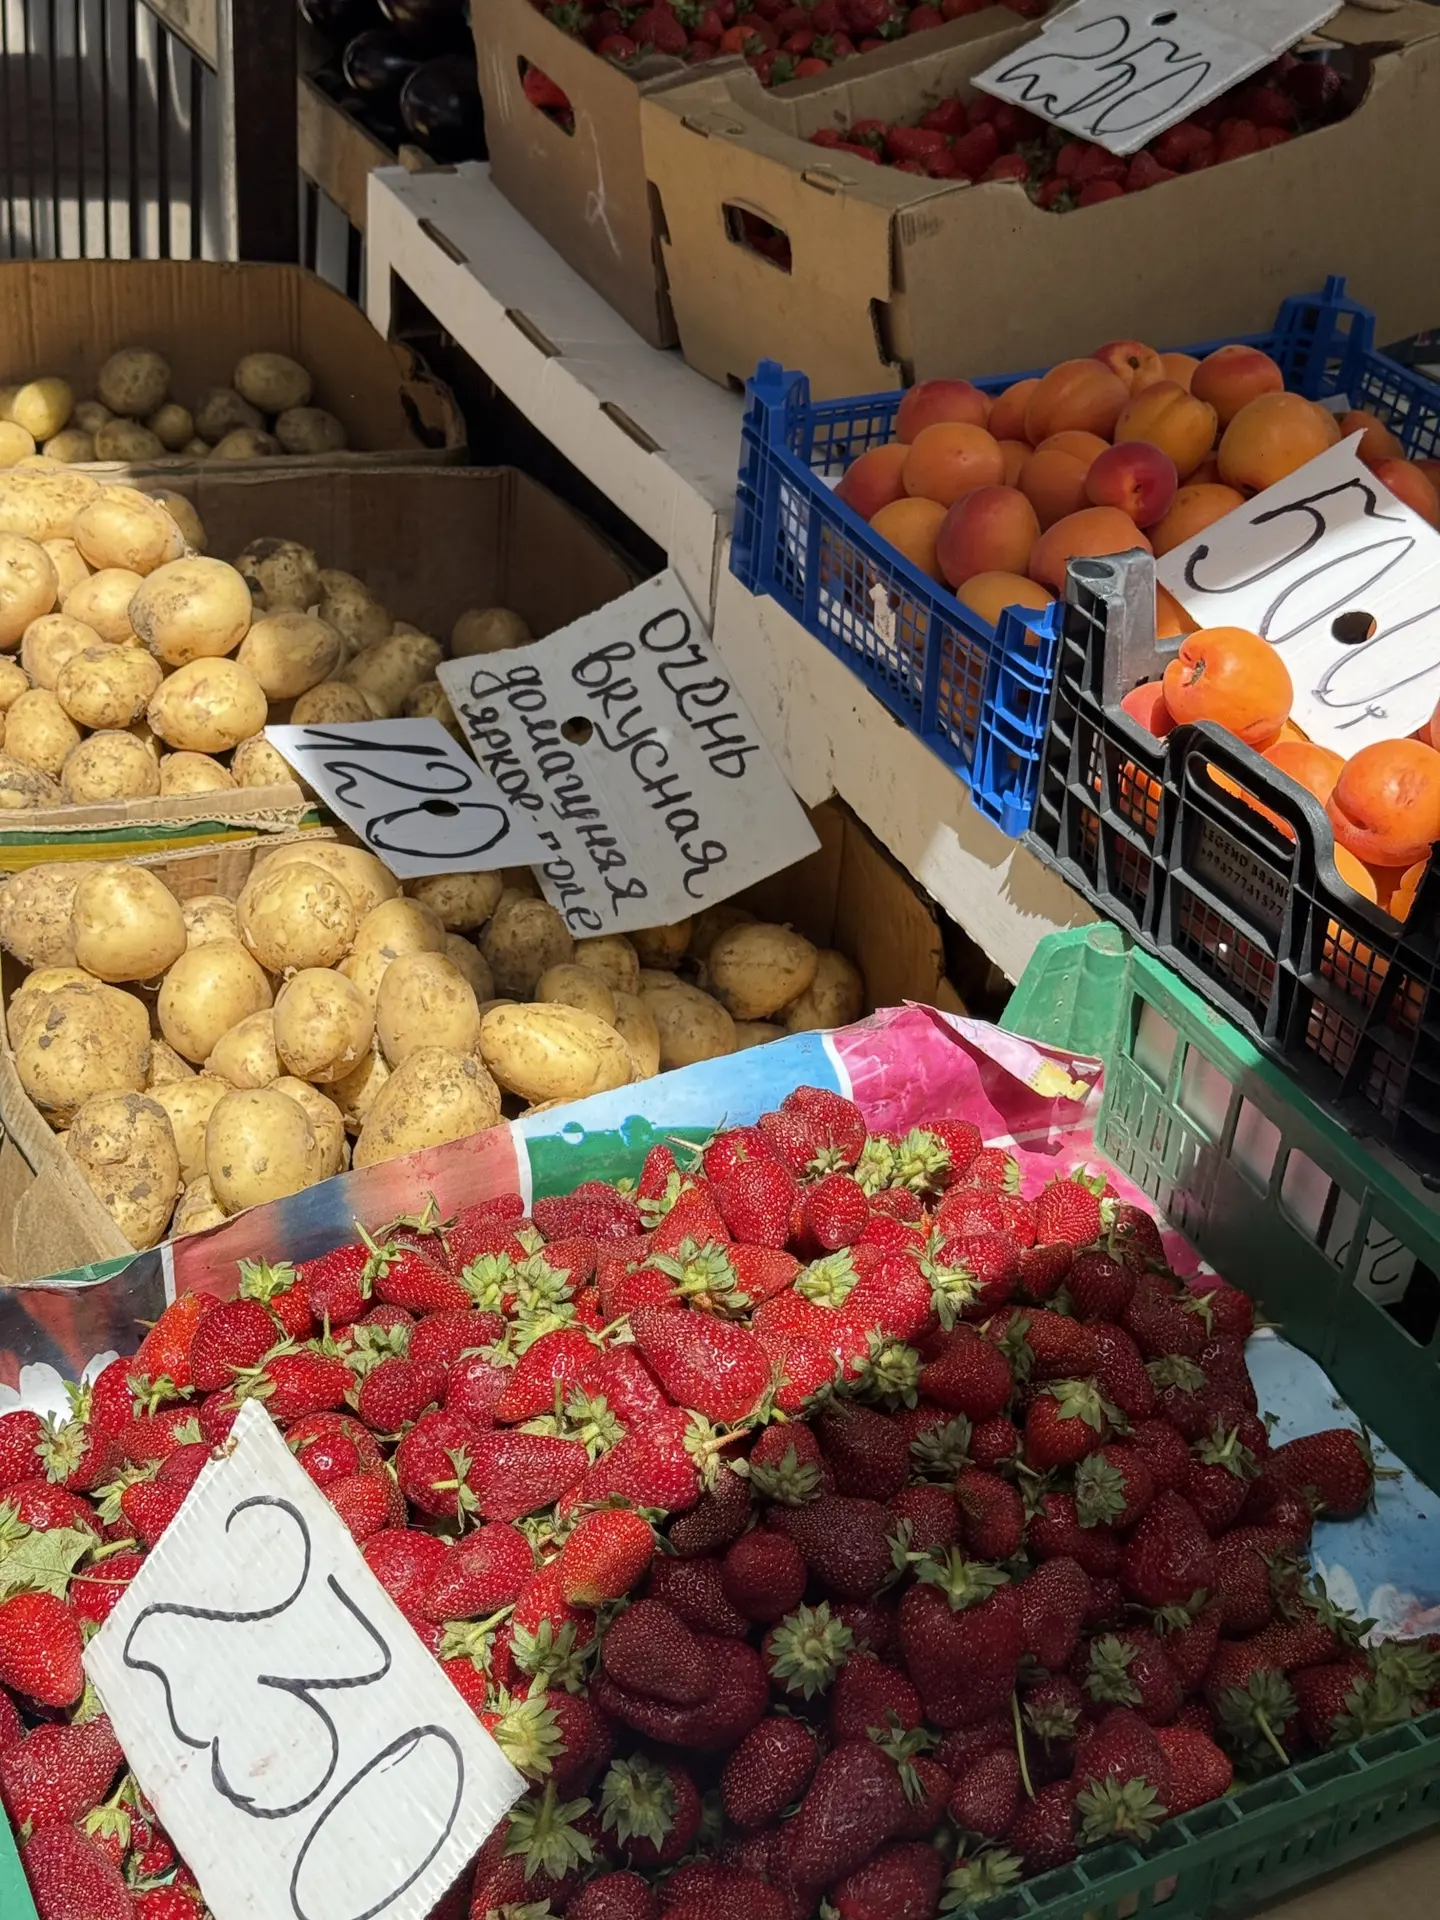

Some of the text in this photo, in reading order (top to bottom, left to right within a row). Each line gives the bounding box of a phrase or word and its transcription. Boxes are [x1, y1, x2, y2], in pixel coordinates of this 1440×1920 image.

[996, 15, 1211, 136] 250
[294, 728, 511, 858] 120
[571, 641, 728, 898] вкусная
[1202, 824, 1249, 868] LEGEND
[123, 1494, 465, 1920] 230
